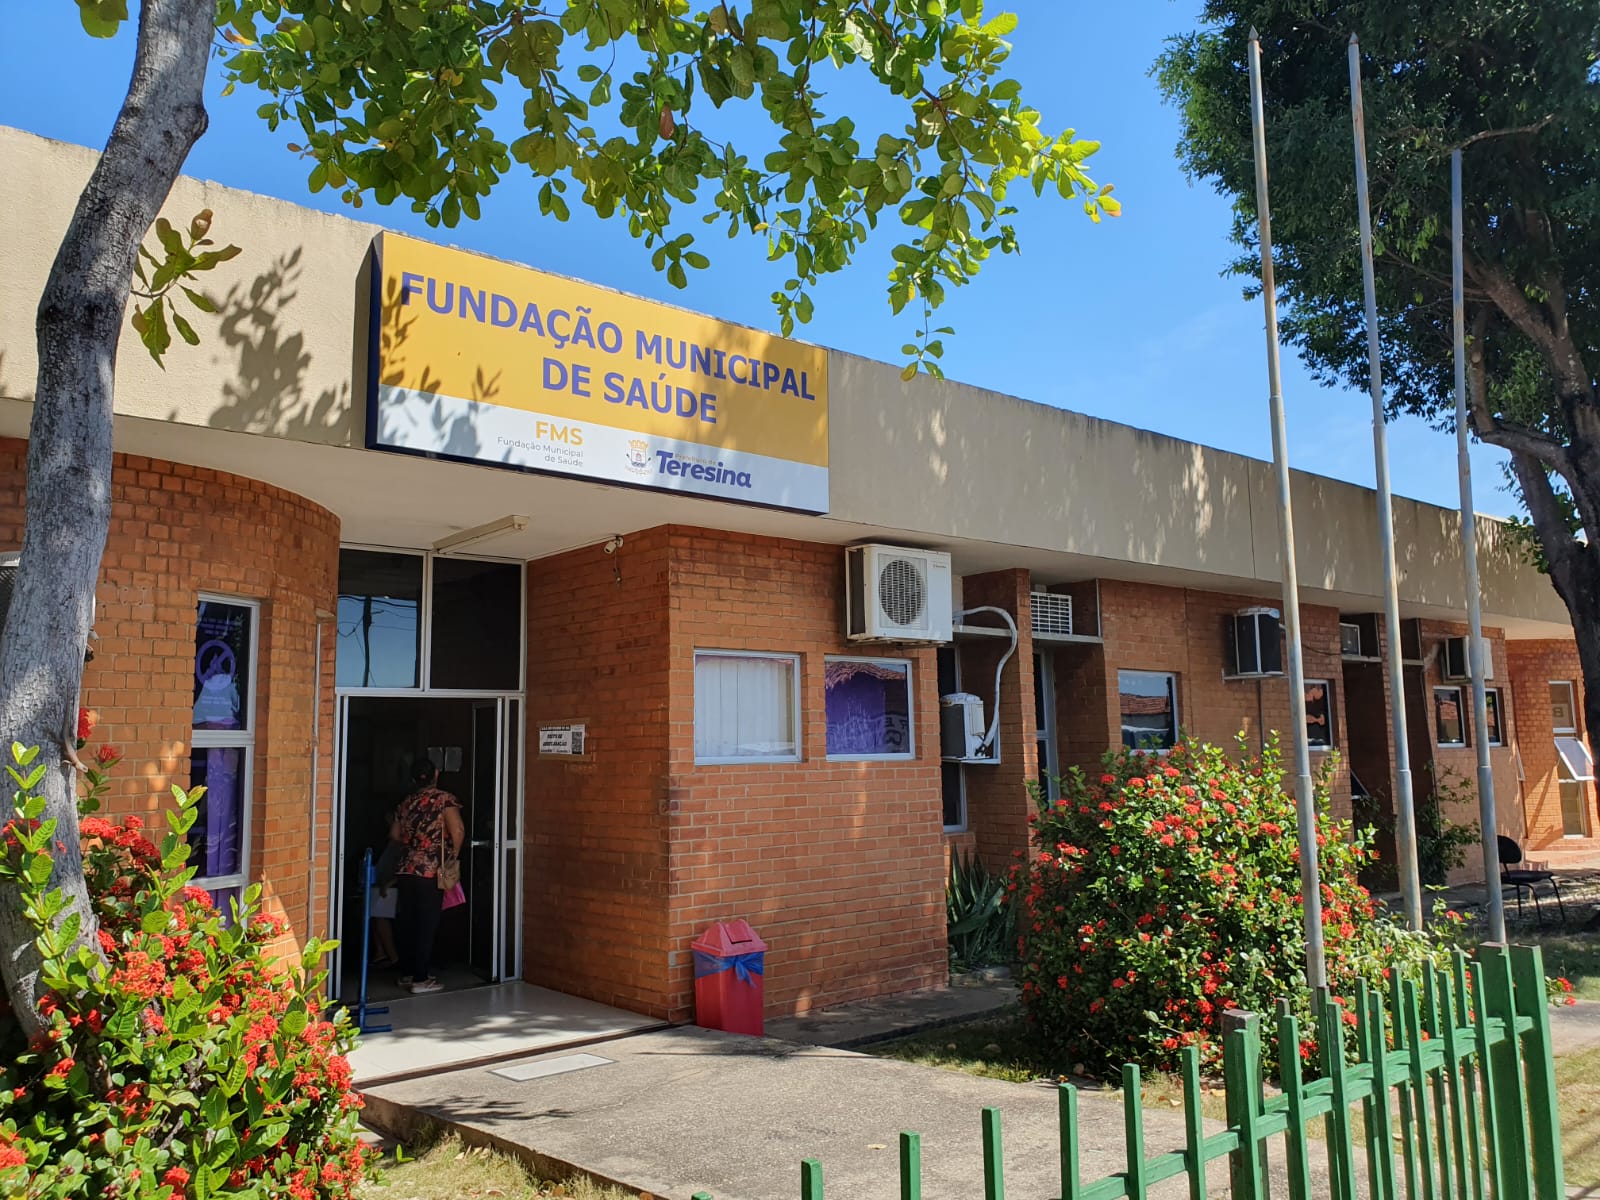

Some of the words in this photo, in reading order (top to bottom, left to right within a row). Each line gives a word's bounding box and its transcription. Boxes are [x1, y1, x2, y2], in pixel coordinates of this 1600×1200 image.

[401, 271, 623, 353] FUNDAÇÃO
[635, 329, 816, 401] MUNICIPAL
[542, 357, 592, 398] DE
[603, 373, 718, 424] SAÚDE
[497, 436, 542, 451] Fundação
[543, 444, 584, 458] Municipal
[535, 420, 584, 446] FMS
[544, 455, 556, 463] de
[656, 449, 752, 489] Teresina
